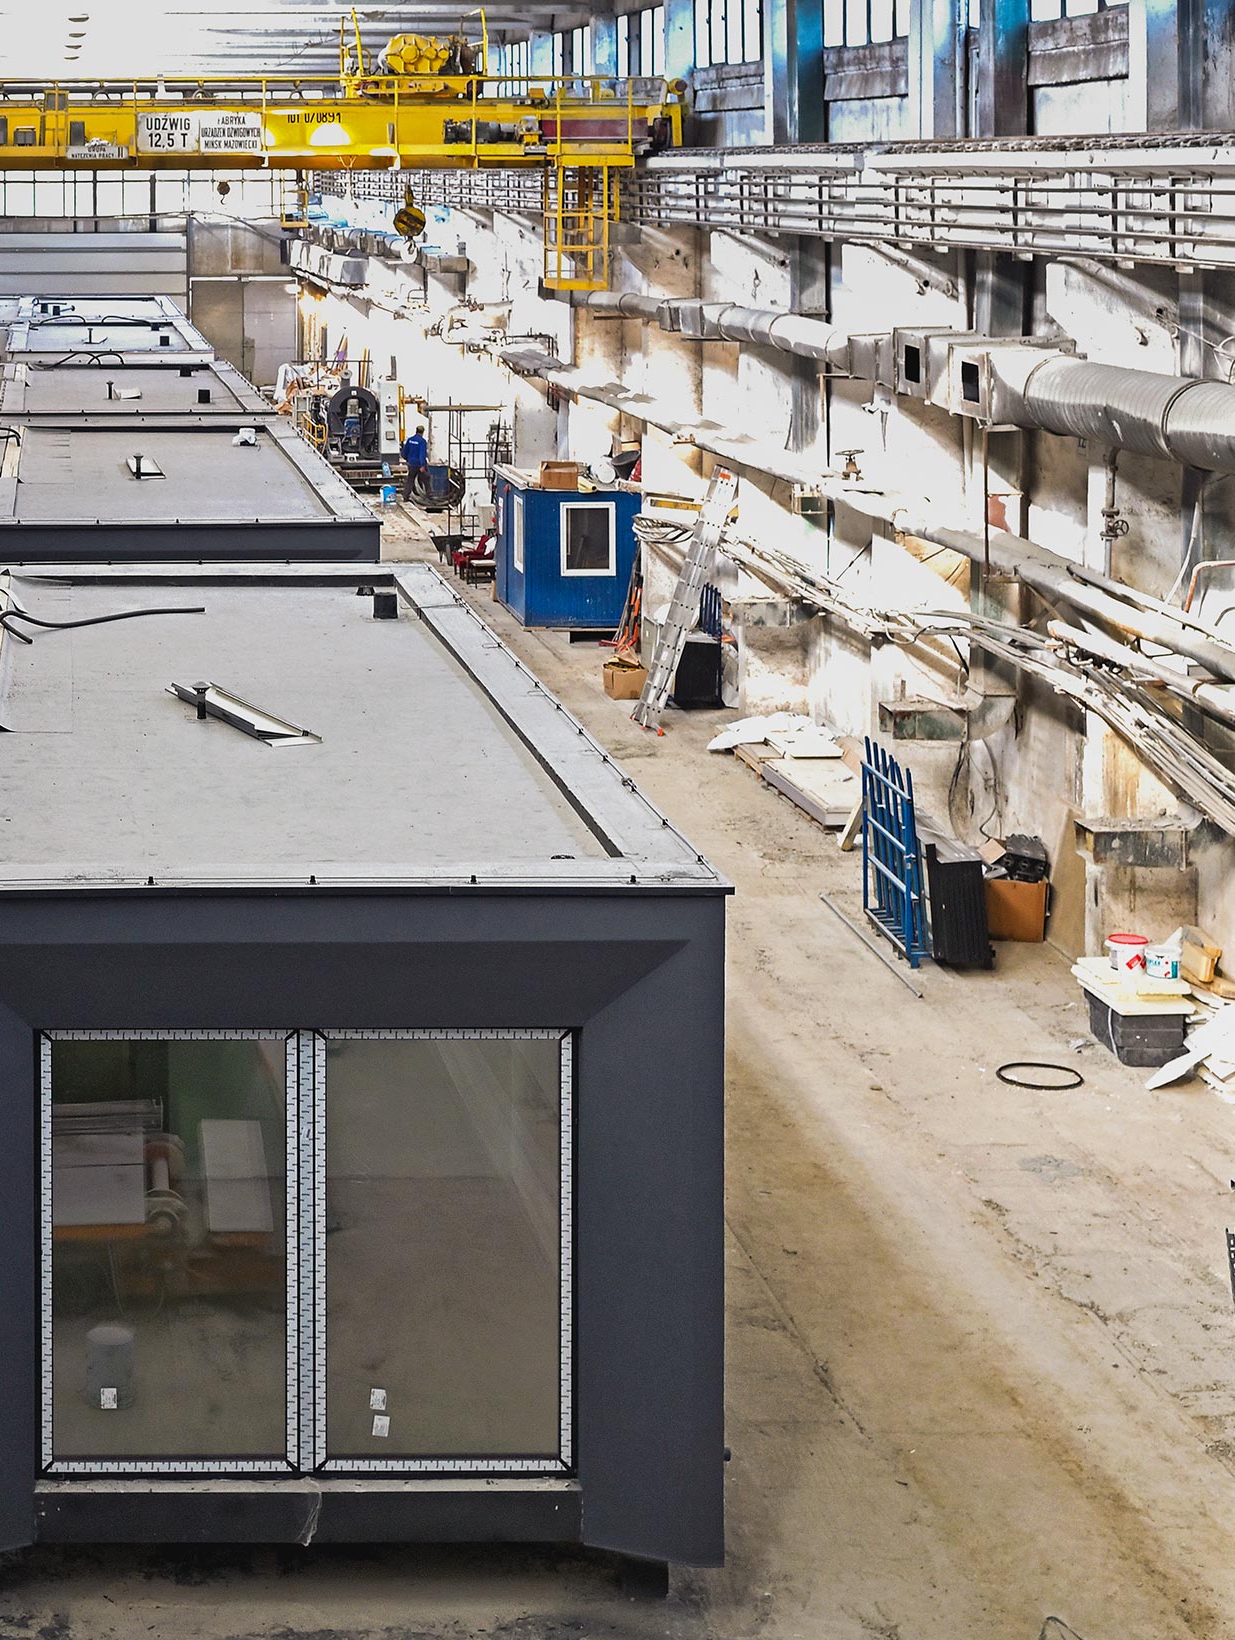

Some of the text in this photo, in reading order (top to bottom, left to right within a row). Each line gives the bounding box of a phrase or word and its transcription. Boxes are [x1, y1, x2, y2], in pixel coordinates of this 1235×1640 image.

[146, 114, 191, 131] UDŹWIG
[148, 132, 188, 149] 12,5 T
[223, 139, 258, 149] MAZOWIECKI
